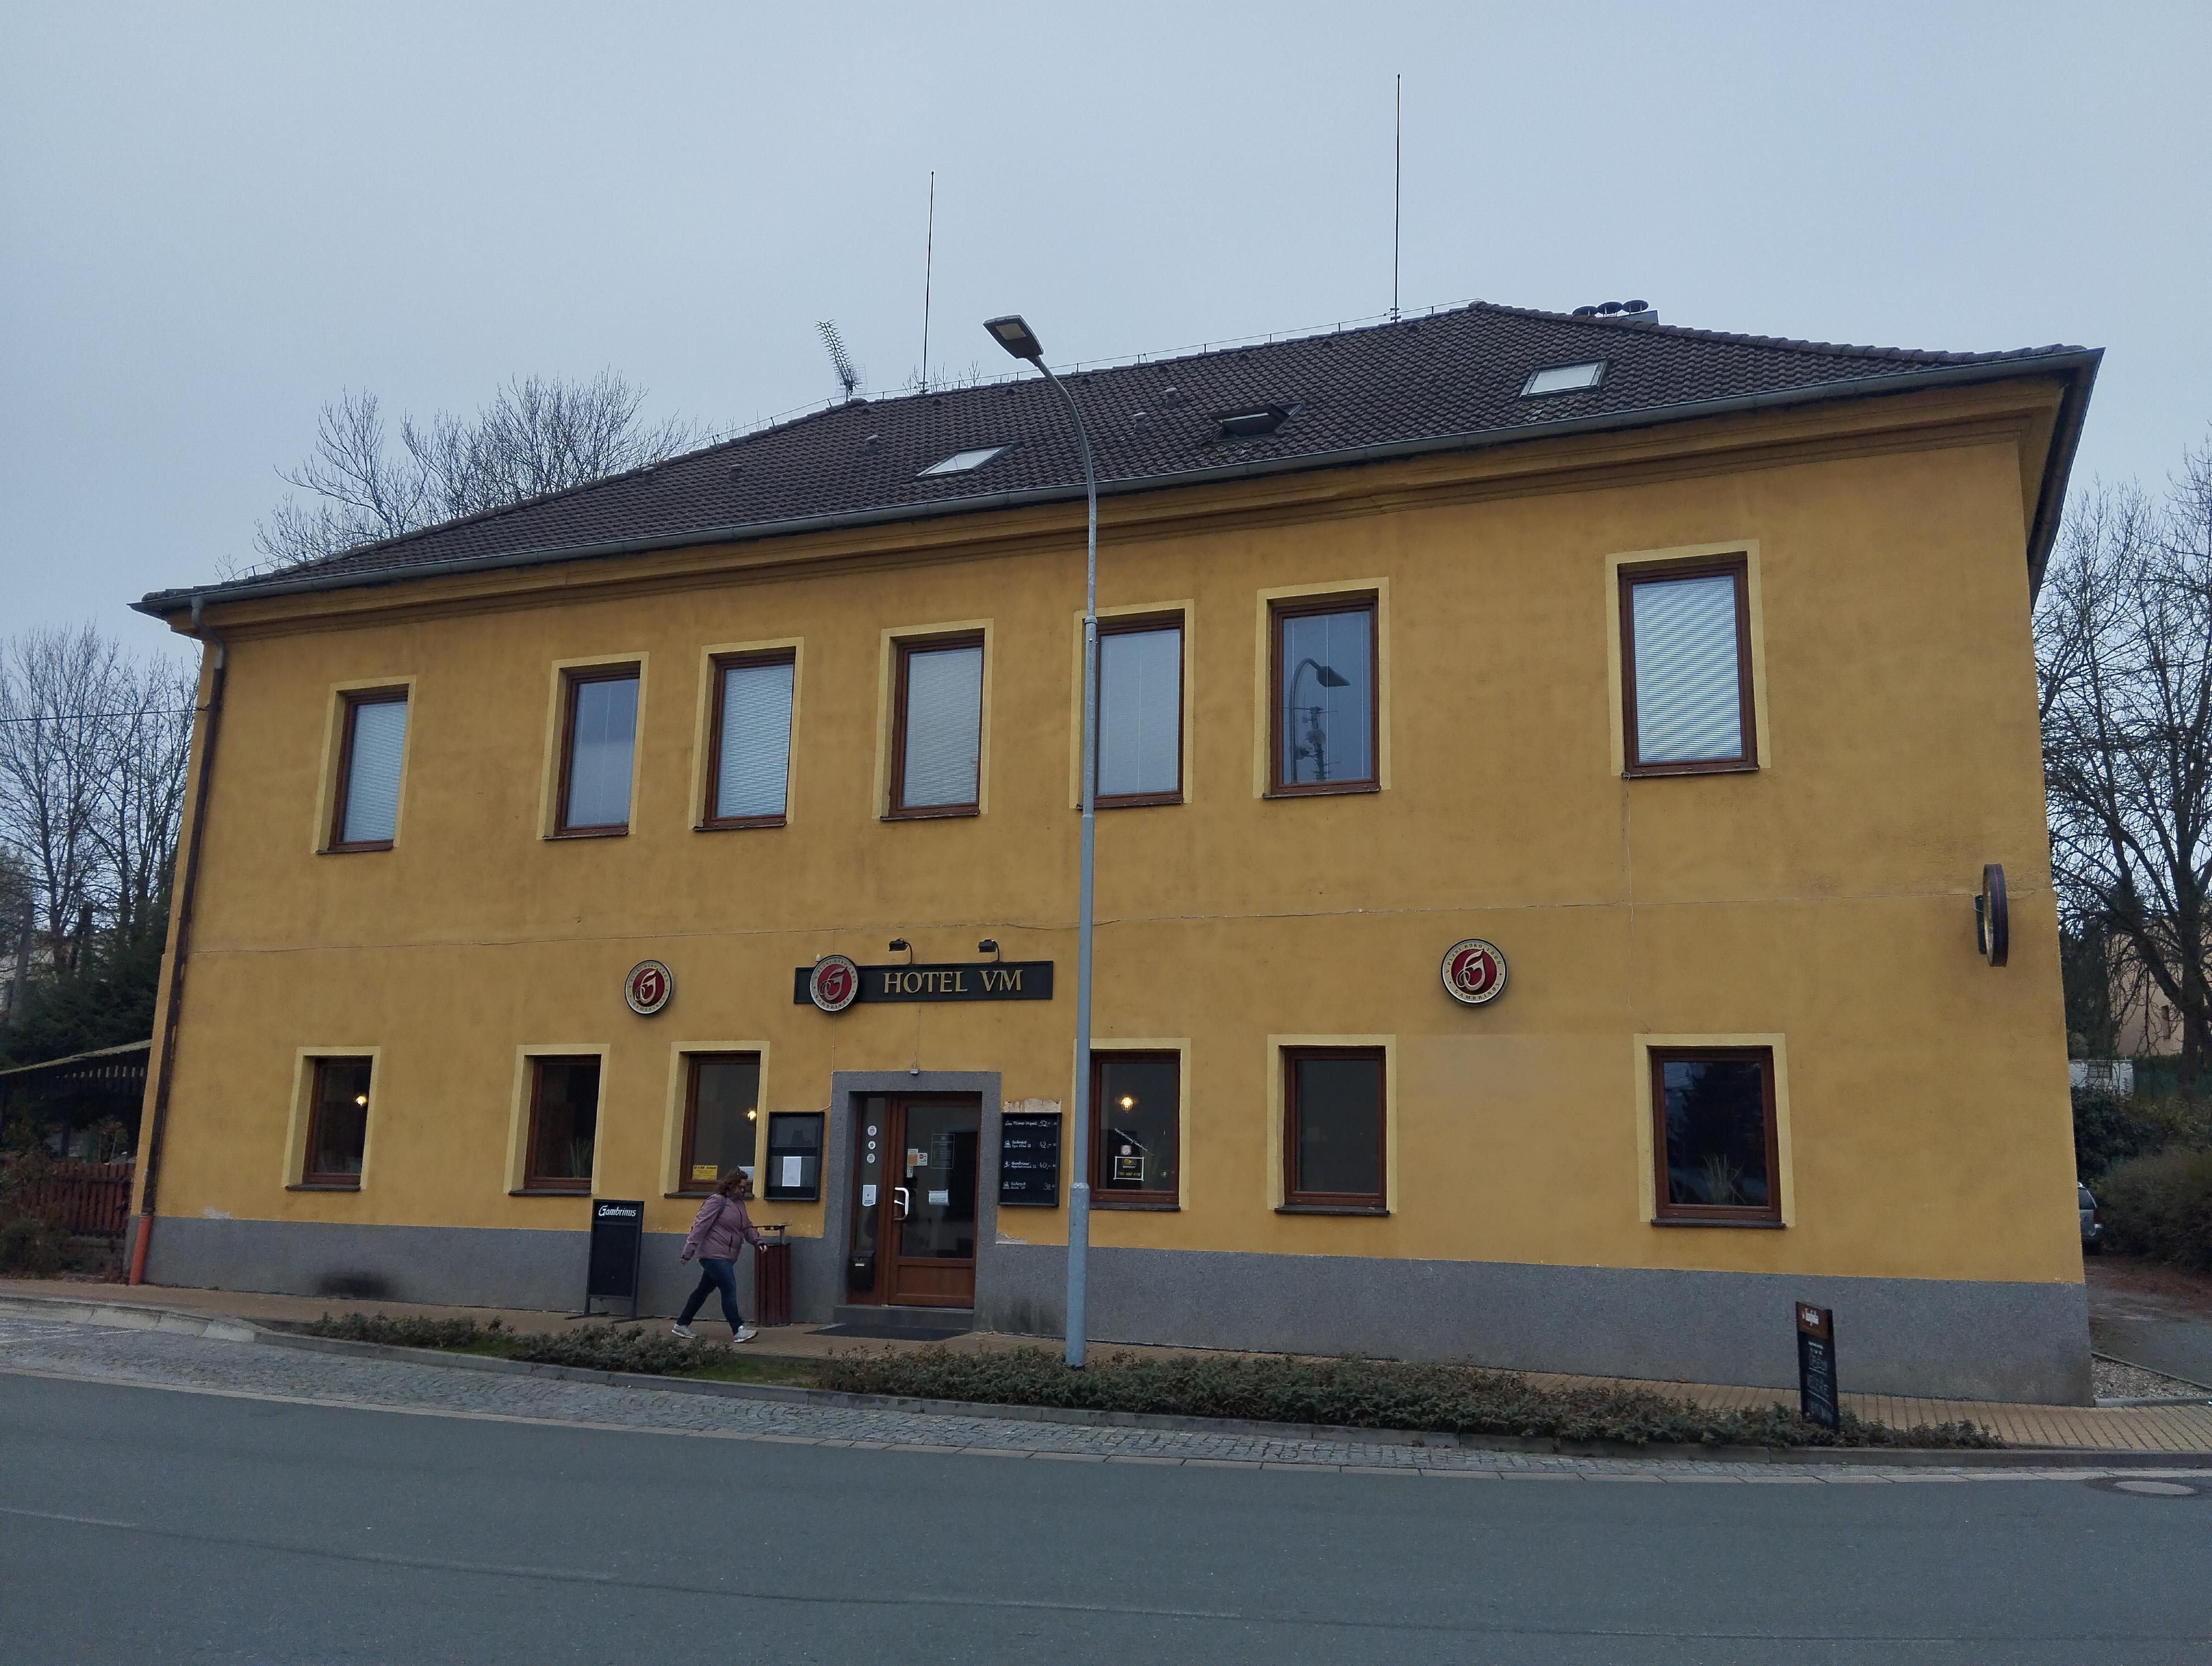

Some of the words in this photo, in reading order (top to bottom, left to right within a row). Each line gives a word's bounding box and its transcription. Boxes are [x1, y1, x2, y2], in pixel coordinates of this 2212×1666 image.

[883, 971, 968, 993] HOTEL
[979, 970, 1023, 991] VM
[598, 1205, 637, 1217] Gambrinus
